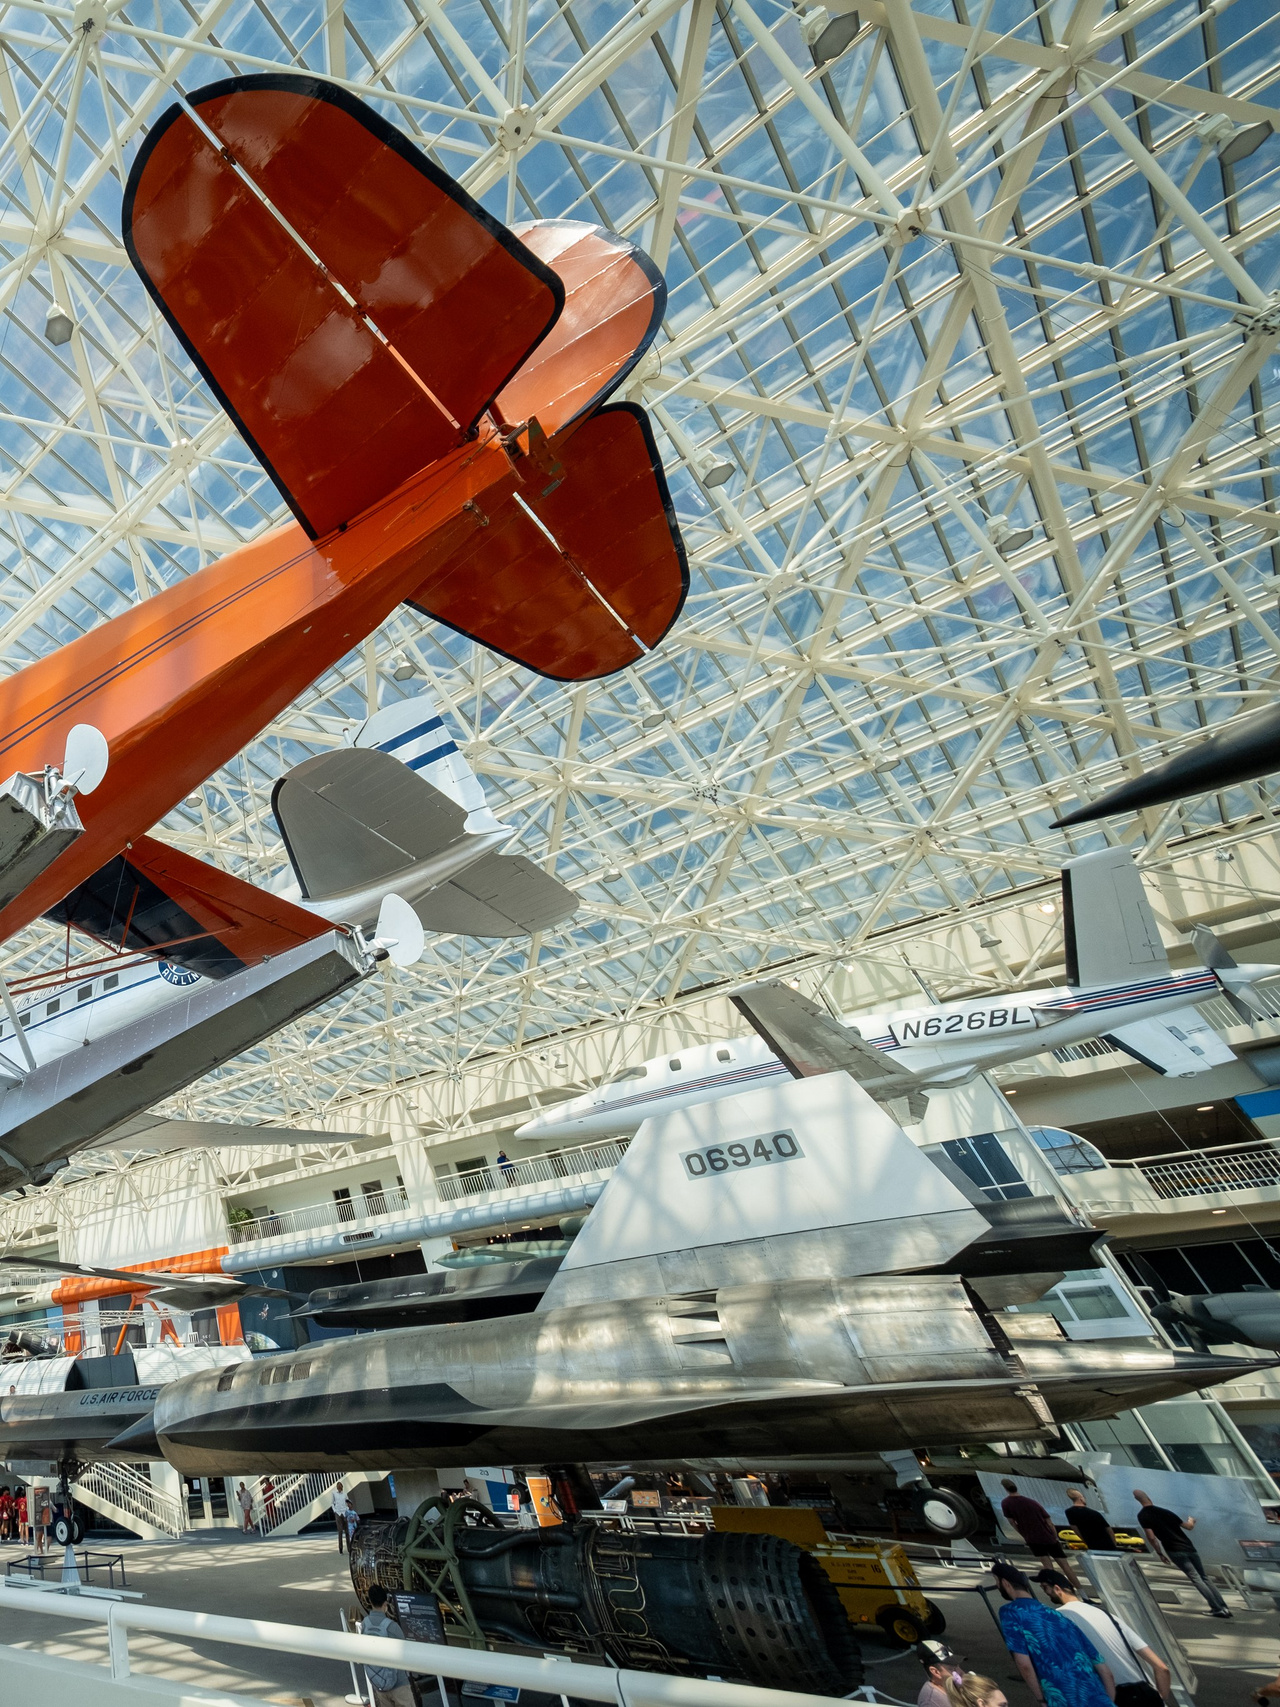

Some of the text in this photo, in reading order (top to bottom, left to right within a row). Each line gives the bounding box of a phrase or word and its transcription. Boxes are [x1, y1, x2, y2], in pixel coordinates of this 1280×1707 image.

[902, 1007, 1031, 1040] N626BL
[685, 1133, 798, 1176] 06940
[99, 1391, 119, 1404] AIR
[119, 1388, 161, 1402] FORCE
[870, 1564, 882, 1574] 16
